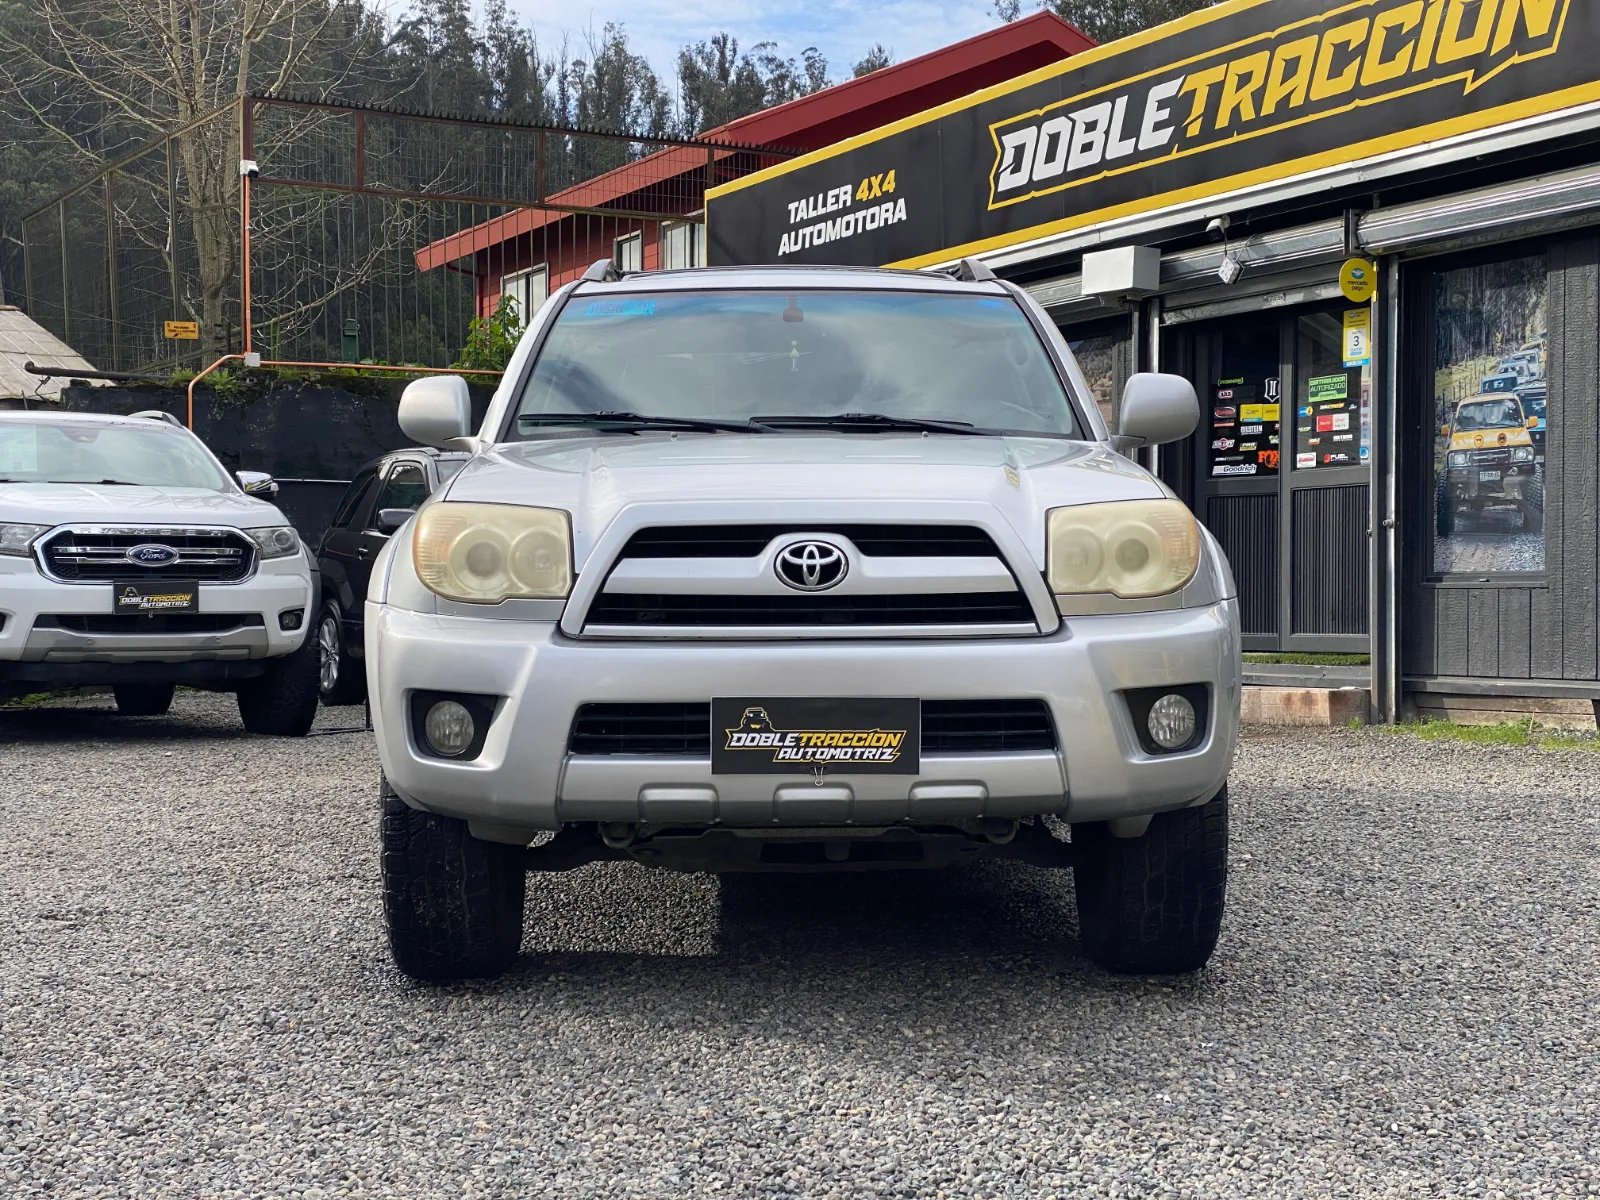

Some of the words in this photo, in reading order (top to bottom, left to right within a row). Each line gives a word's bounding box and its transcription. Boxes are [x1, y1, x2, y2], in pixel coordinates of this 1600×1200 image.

[788, 184, 853, 224] TALLER
[855, 169, 896, 202] 4X4
[778, 197, 907, 256] AUTOMOTORA
[1353, 335, 1360, 347] 3
[1310, 382, 1346, 392] AUTORIZADO
[1240, 425, 1263, 433] BILSTEIN
[140, 548, 167, 559] Ford
[777, 748, 895, 760] AUTOMOTRIZ
